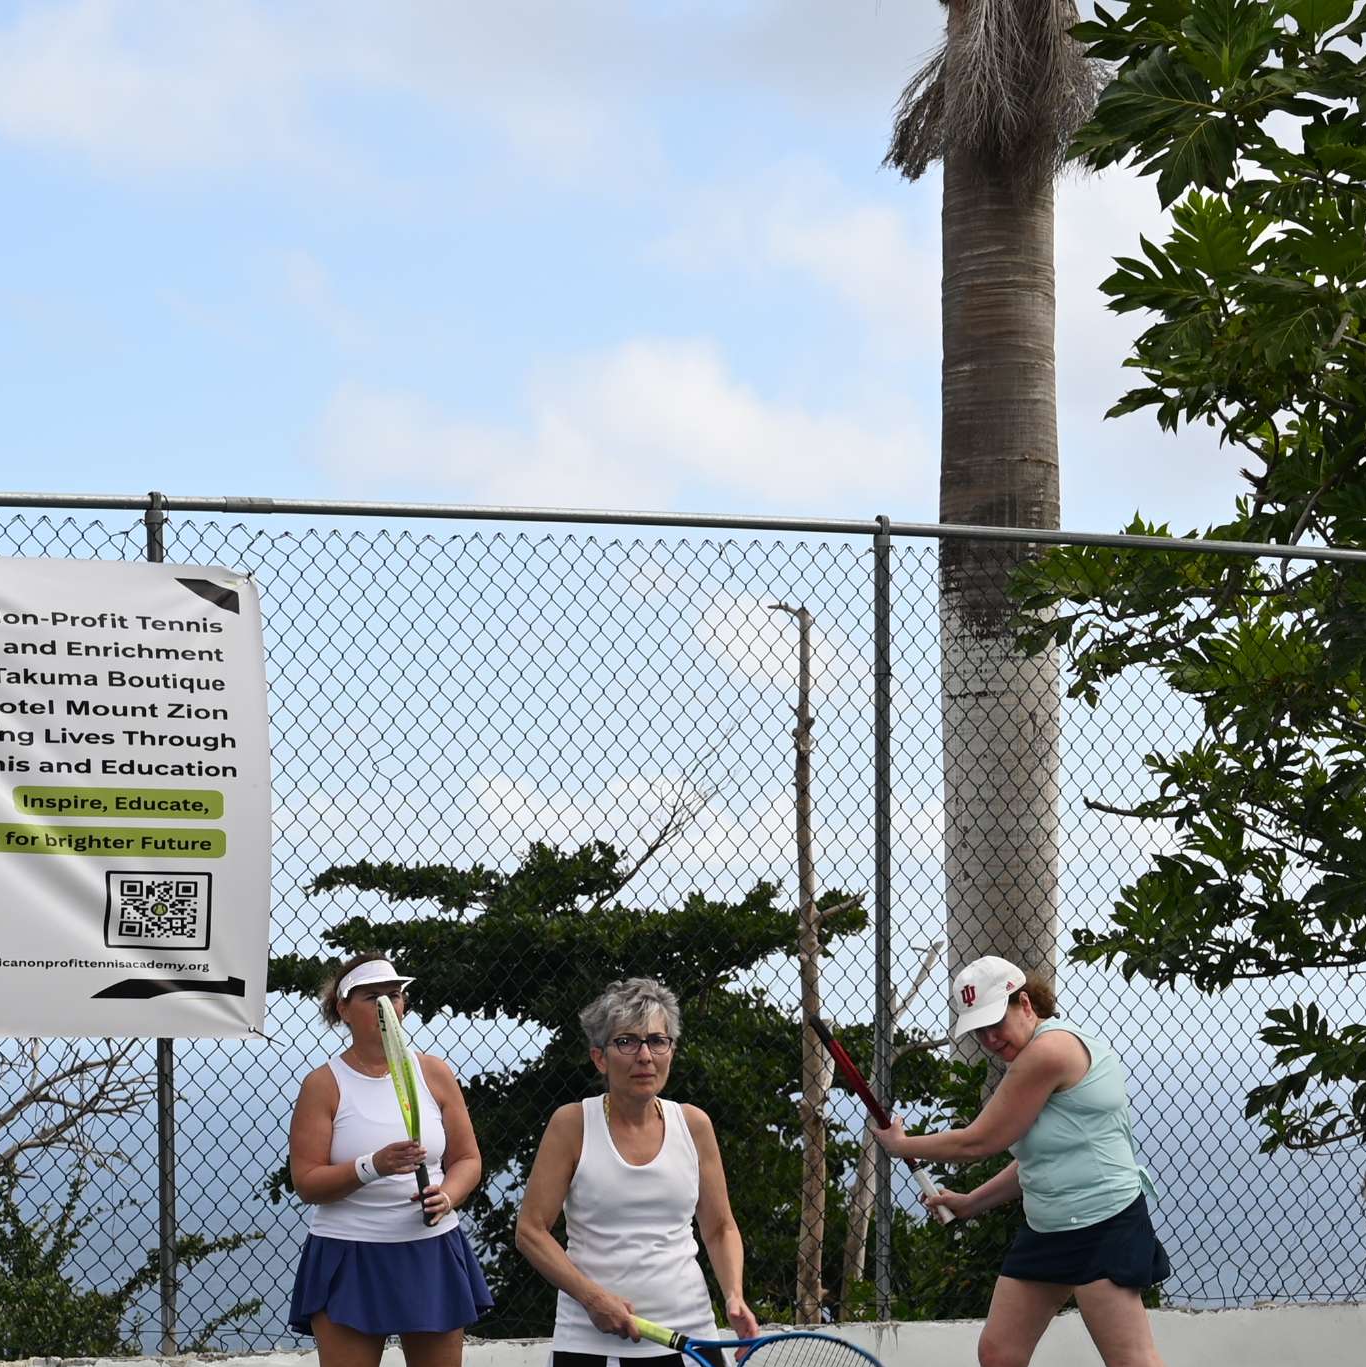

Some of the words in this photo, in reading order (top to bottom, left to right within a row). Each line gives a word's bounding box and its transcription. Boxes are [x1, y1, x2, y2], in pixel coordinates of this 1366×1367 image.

[136, 615, 223, 633] Tennis
[3, 640, 56, 656] and
[67, 641, 224, 663] Enrichment
[108, 670, 225, 693] Boutique
[66, 699, 158, 718] Mount
[166, 703, 228, 720] Zion
[44, 728, 115, 745] Lives
[123, 730, 237, 751] Through
[38, 758, 92, 775] and
[101, 759, 237, 778] Education
[23, 794, 108, 813] Inspire,
[115, 796, 210, 815] Educate,
[6, 830, 39, 846] for
[45, 833, 135, 852] brighter
[141, 836, 212, 851] Future
